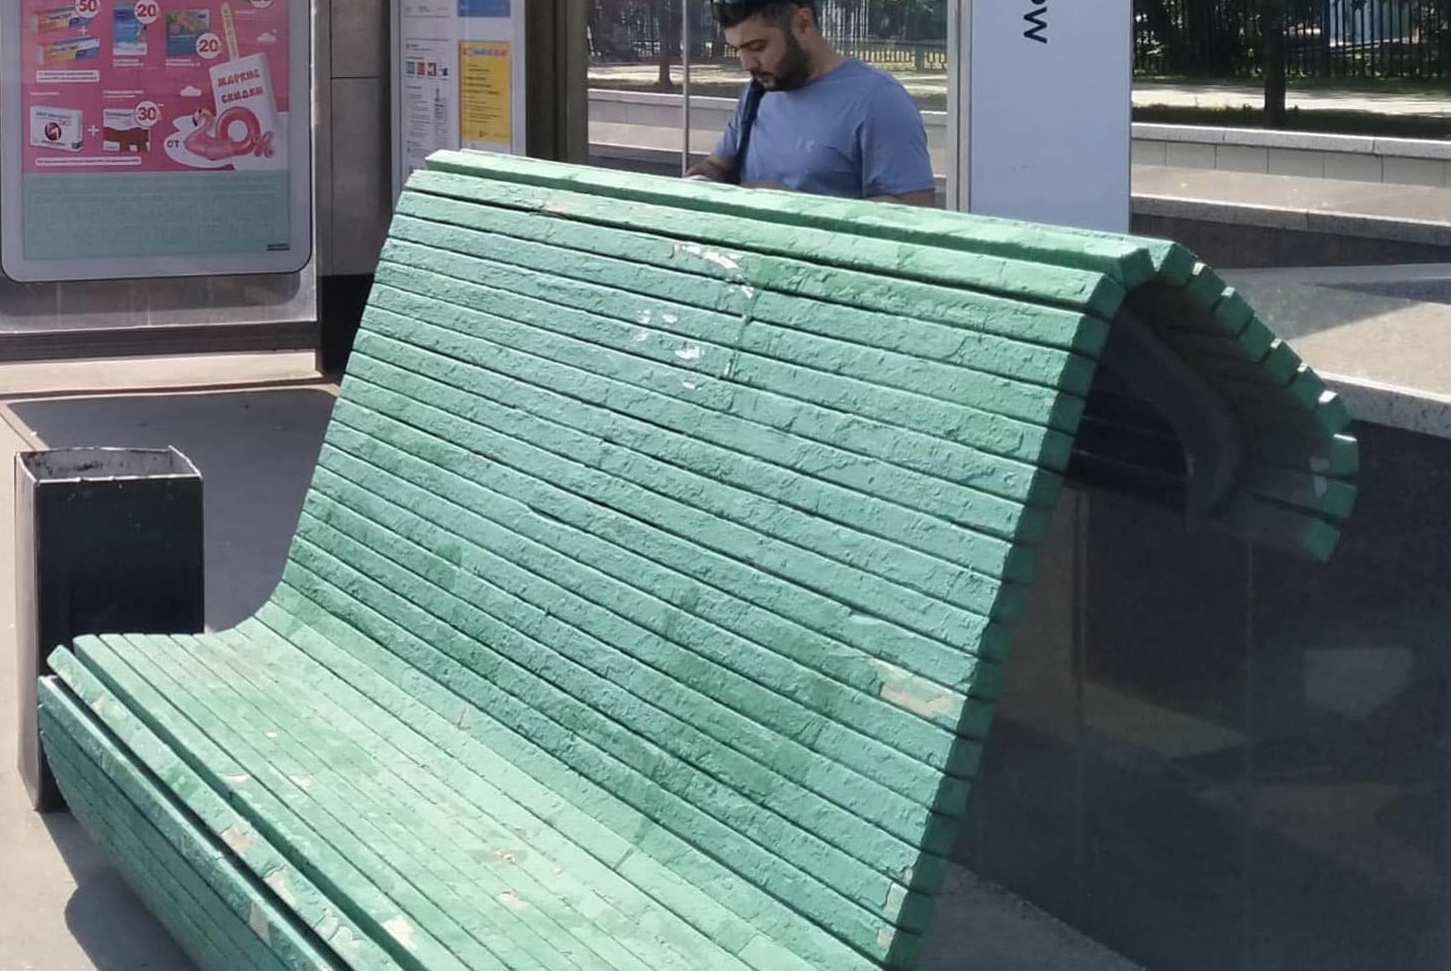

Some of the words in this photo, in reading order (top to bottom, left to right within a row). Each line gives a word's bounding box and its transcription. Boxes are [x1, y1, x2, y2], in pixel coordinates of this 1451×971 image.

[79, 0, 97, 12] 50
[137, 4, 157, 17] 20
[199, 39, 218, 52] 20
[138, 107, 157, 120] 30
